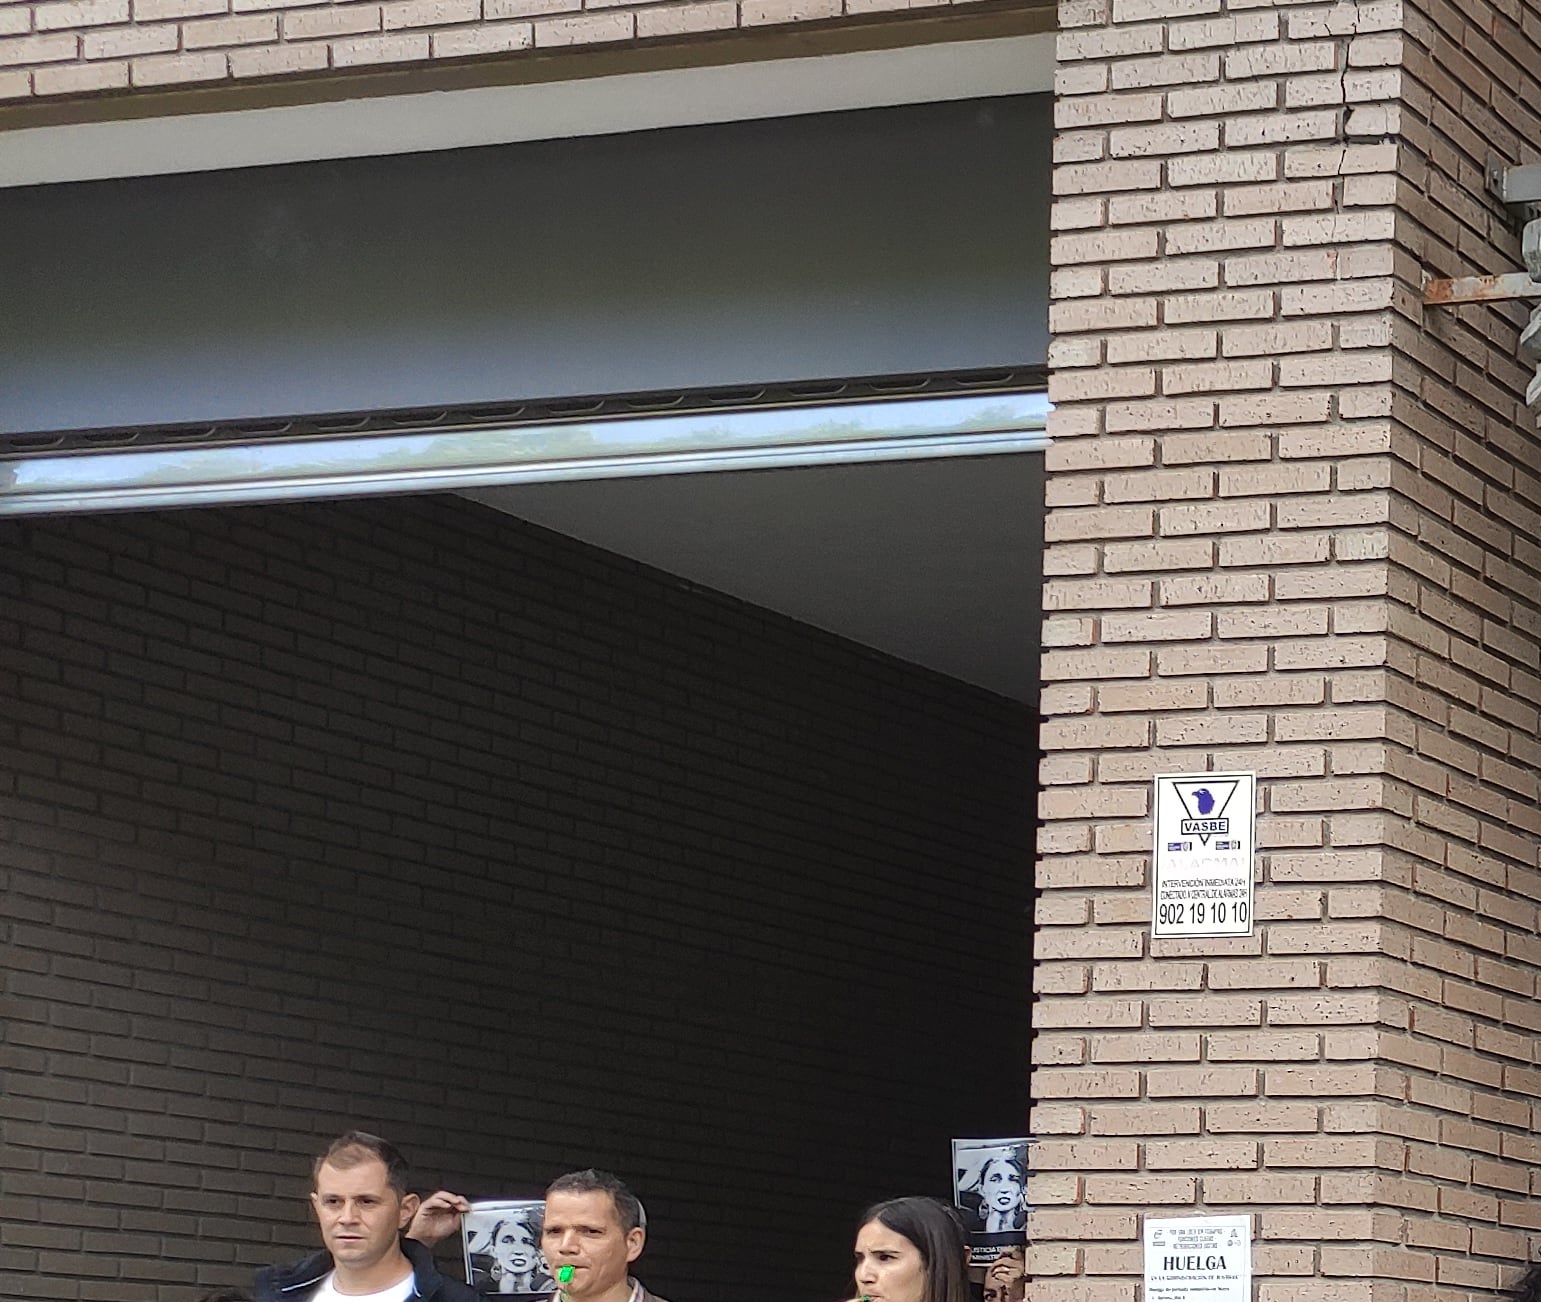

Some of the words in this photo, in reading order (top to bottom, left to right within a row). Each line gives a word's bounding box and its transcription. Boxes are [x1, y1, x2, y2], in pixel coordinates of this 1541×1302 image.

[1184, 821, 1226, 832] VASBE
[1159, 903, 1184, 925] 902
[1189, 902, 1205, 924] 19
[1211, 902, 1226, 923] 10
[1232, 901, 1247, 923] 10
[1163, 1255, 1227, 1271] HUELGA
